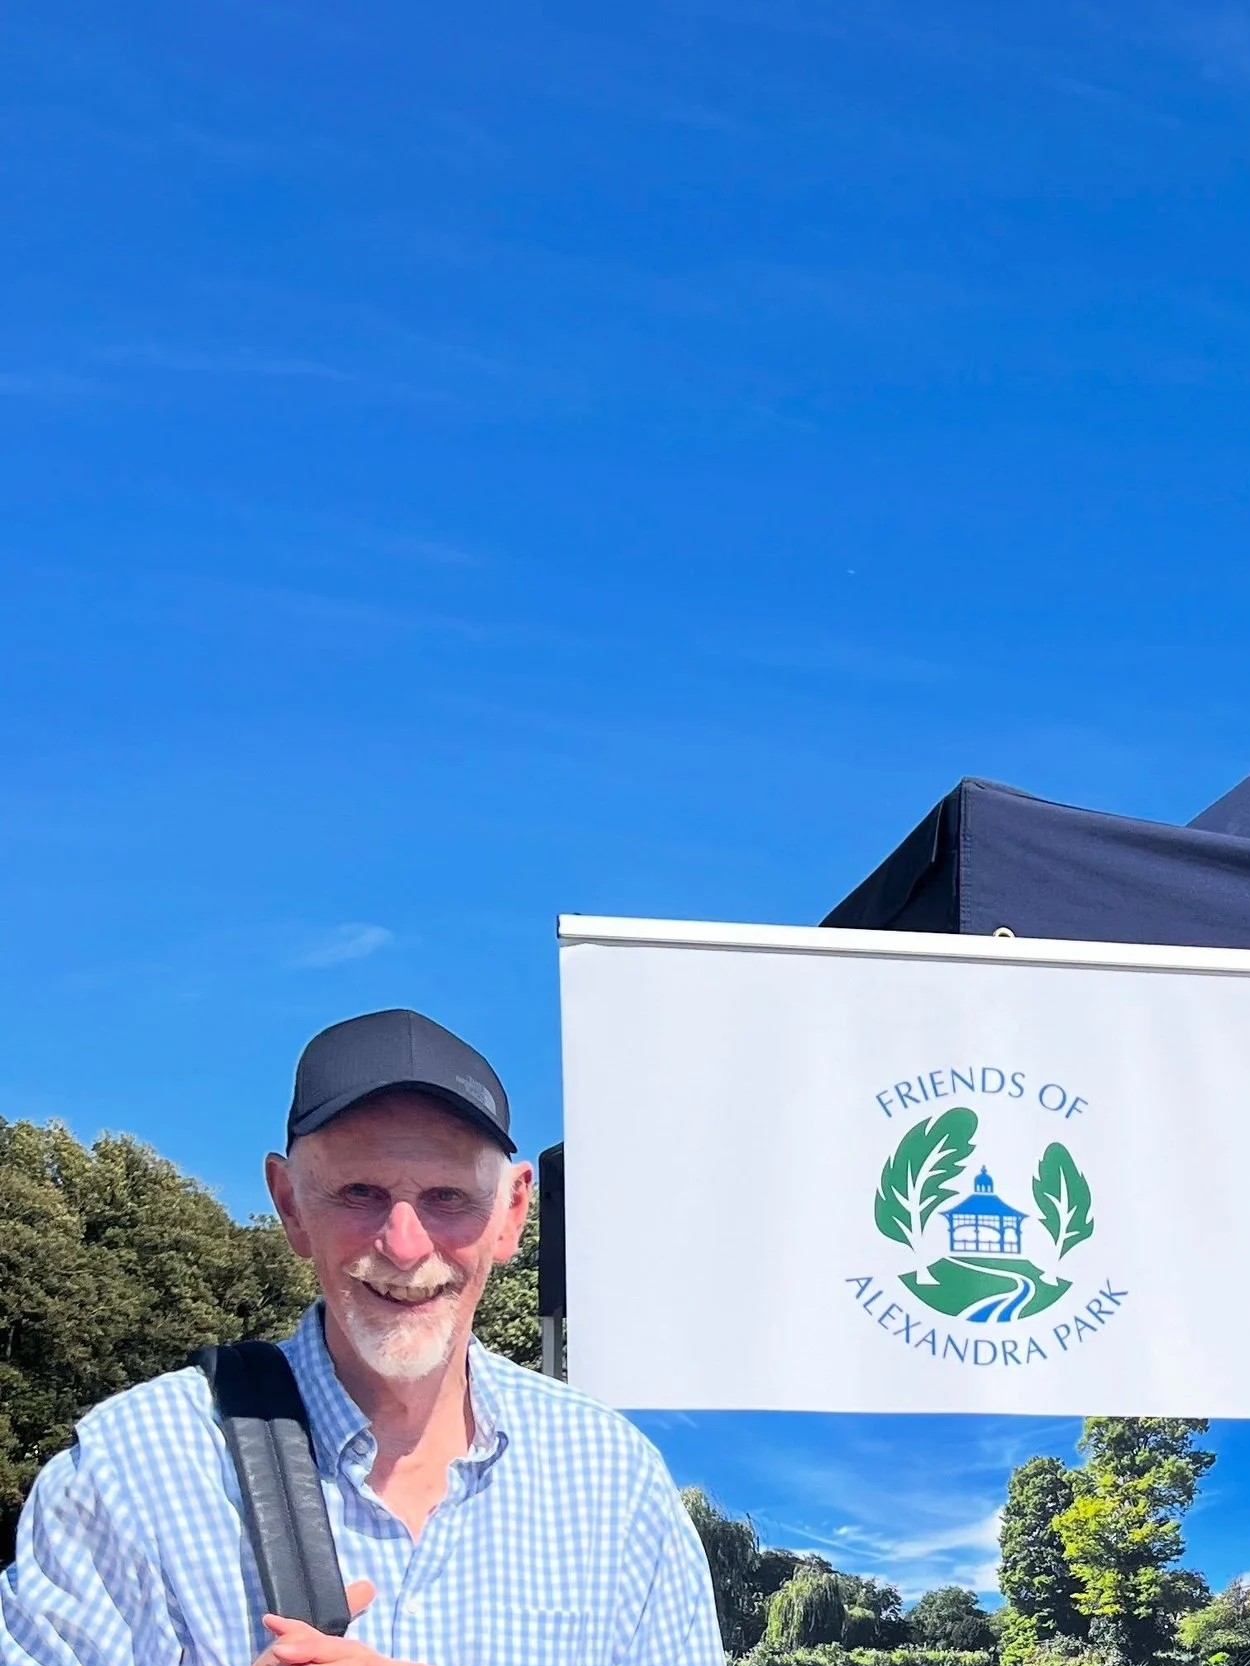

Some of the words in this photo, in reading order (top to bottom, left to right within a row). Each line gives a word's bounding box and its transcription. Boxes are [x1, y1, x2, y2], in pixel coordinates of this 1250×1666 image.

[875, 1066, 1026, 1118] FRIENDS
[1038, 1083, 1089, 1119] OF
[845, 1275, 1048, 1366] ALEXANDRA
[1053, 1278, 1129, 1351] PARK
